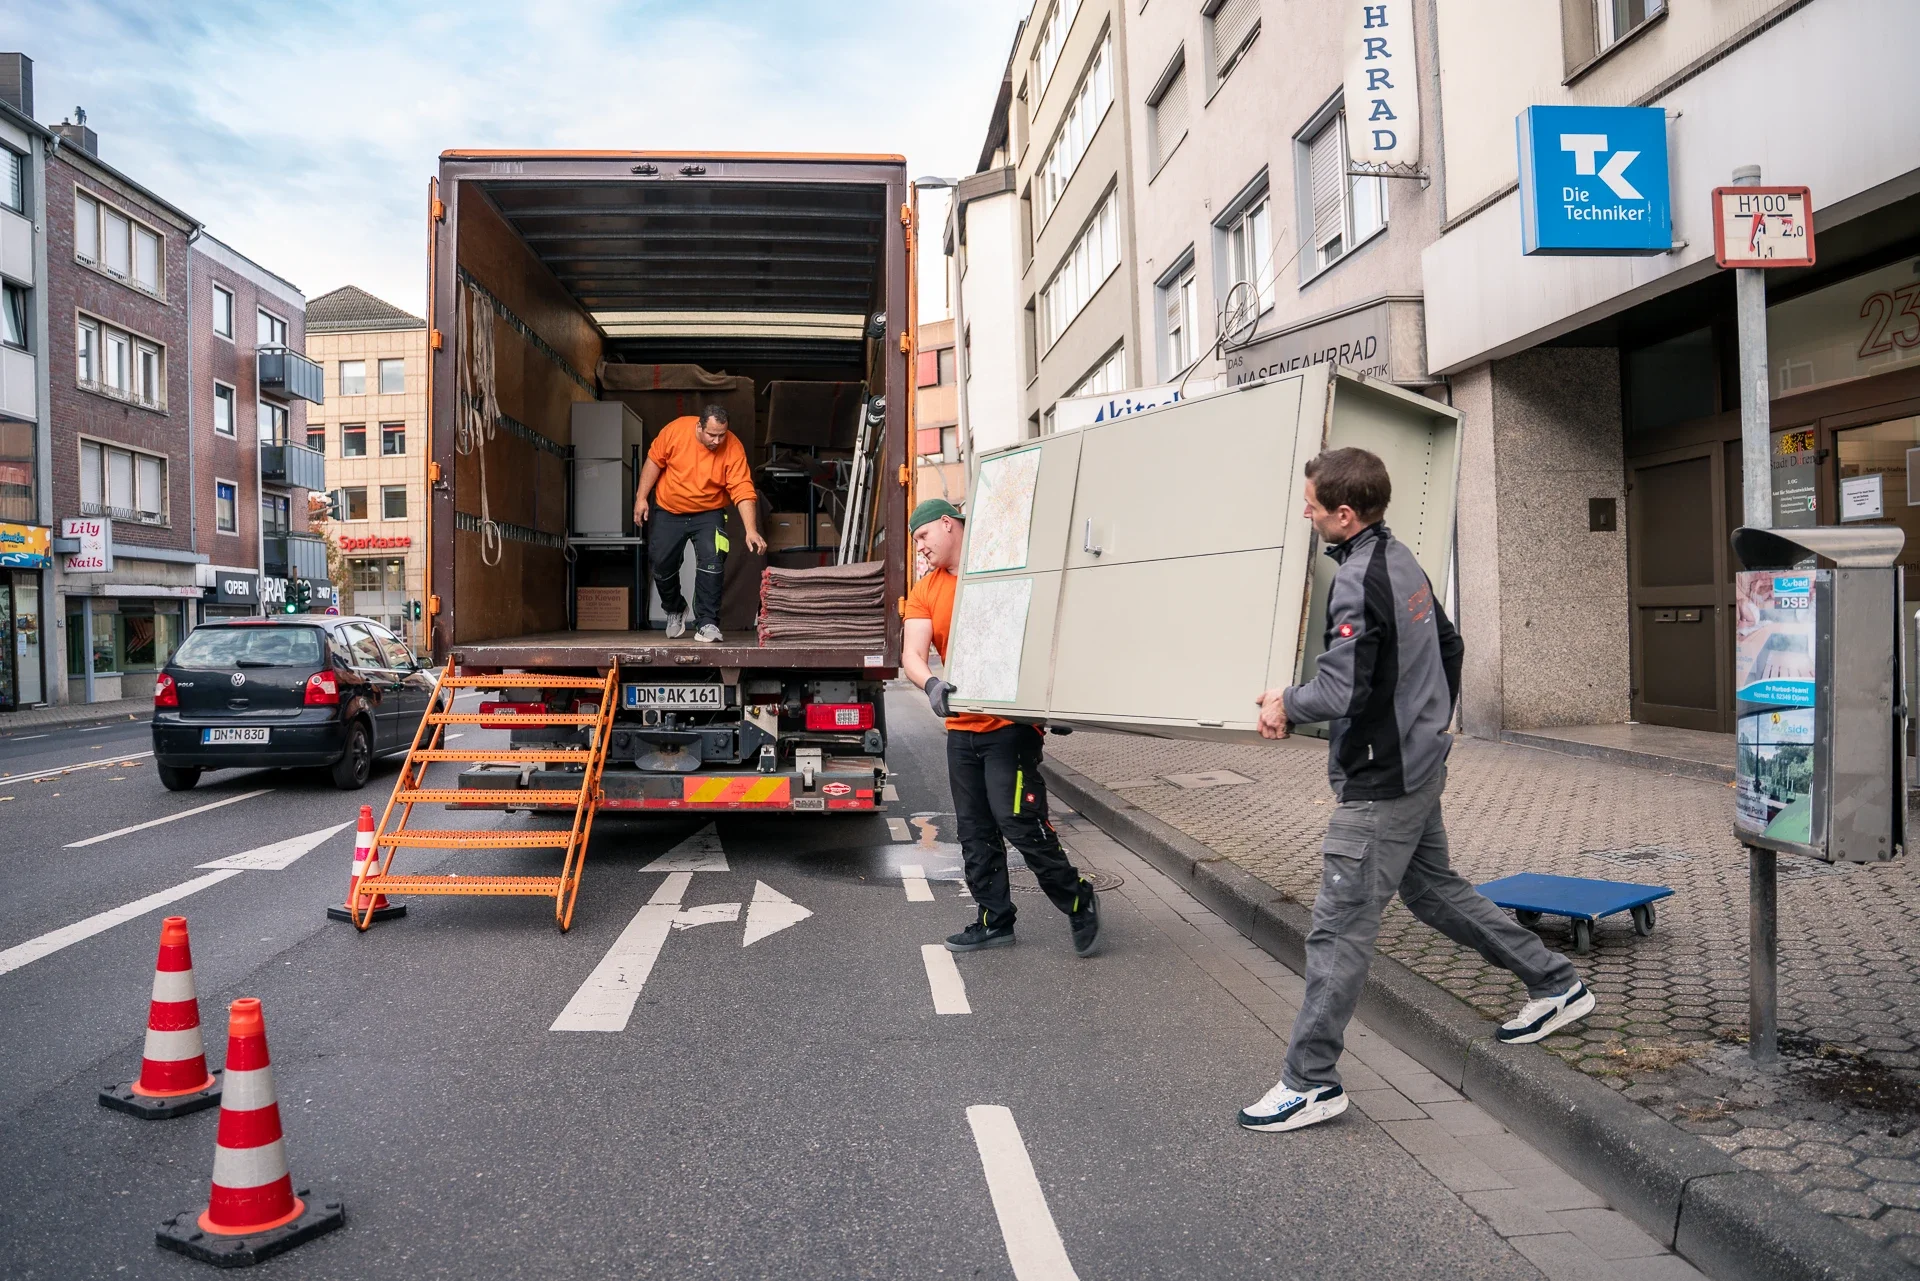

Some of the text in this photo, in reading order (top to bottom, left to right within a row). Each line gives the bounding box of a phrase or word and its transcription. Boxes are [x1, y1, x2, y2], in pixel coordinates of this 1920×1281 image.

[1560, 133, 1645, 199] TK
[1562, 187, 1590, 203] Die
[1739, 195, 1786, 212] H100
[1563, 204, 1645, 221] Techniker
[1858, 283, 1920, 359] 23
[1228, 356, 1243, 370] DAS
[69, 522, 100, 537] Lily
[339, 534, 411, 552] Sparkasse
[67, 557, 104, 568] Nails
[225, 579, 249, 596] OPEN
[1781, 597, 1809, 608] DSB
[637, 688, 717, 703] DN AK 161
[214, 729, 264, 740] DN N 830
[1277, 1096, 1303, 1112] FILA
